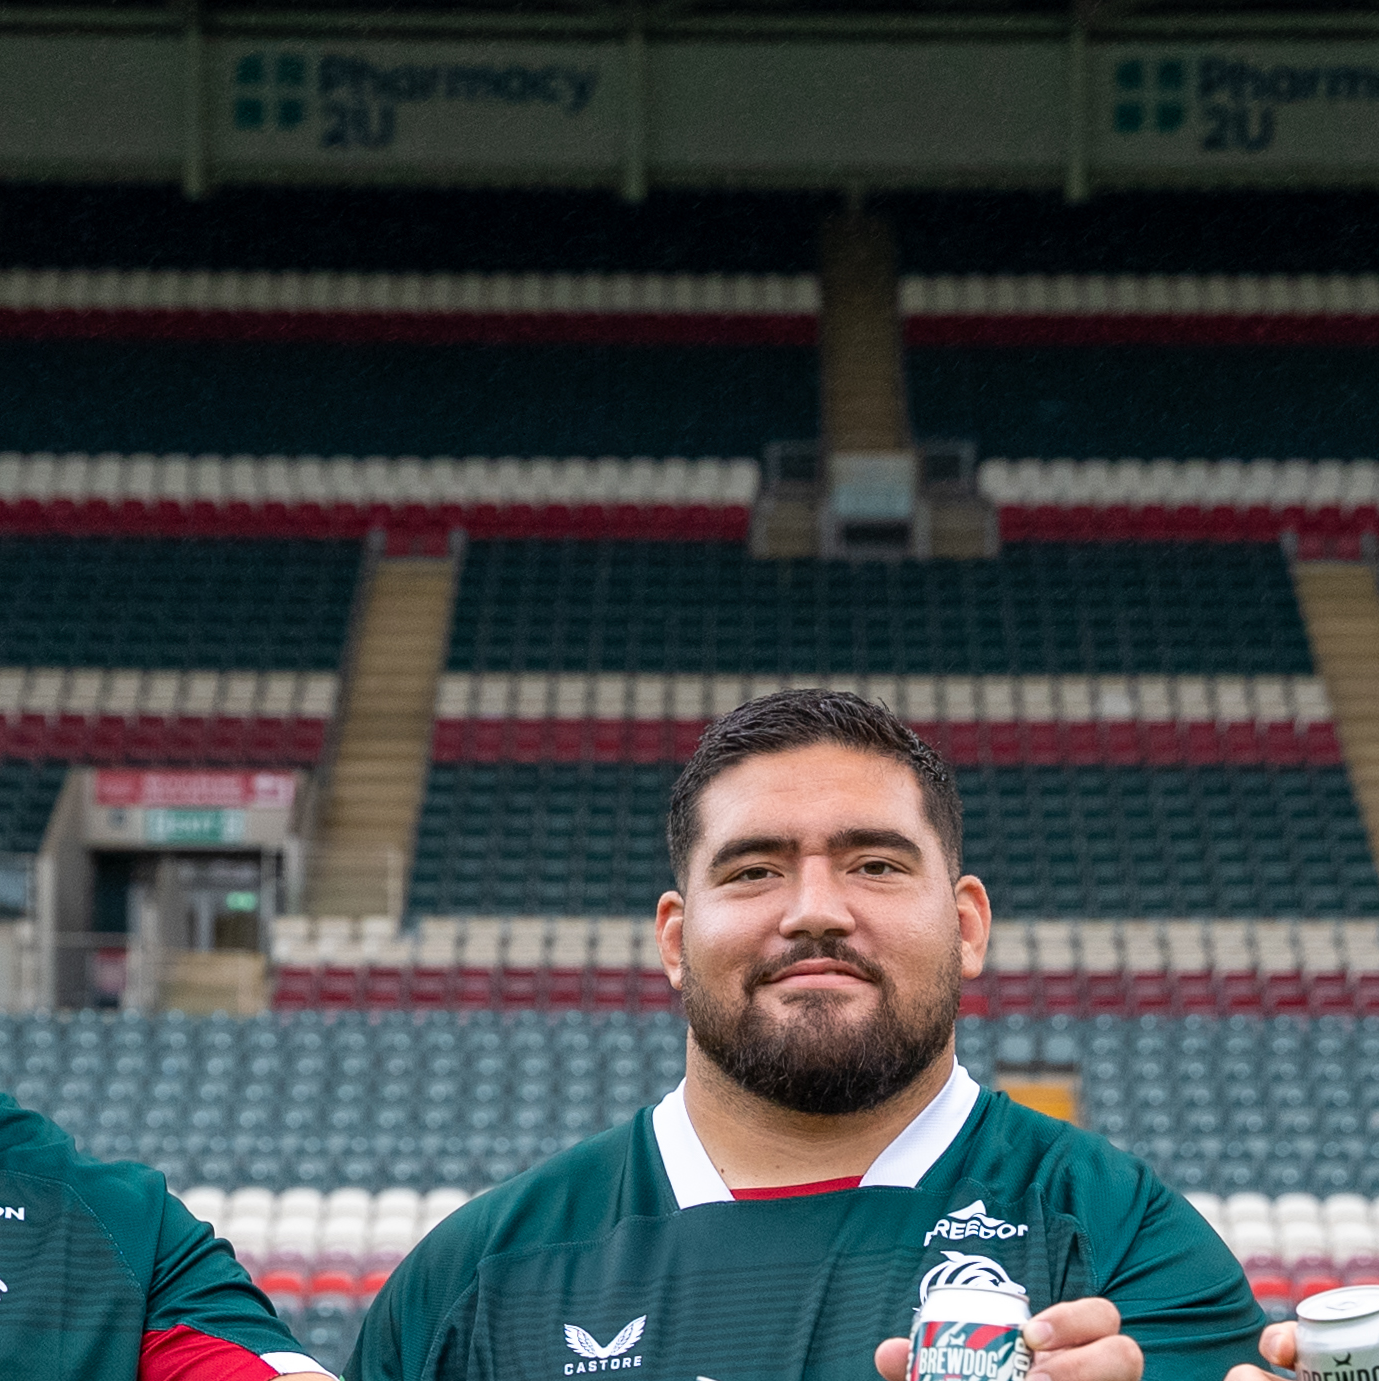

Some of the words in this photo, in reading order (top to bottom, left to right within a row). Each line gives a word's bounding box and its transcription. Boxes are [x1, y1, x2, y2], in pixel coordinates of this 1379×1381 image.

[320, 54, 598, 116] Pharmacy
[322, 104, 396, 148] 2U
[1201, 103, 1277, 152] 2U
[564, 1355, 642, 1376] CASTORE
[918, 1346, 999, 1379] BREWDOG
